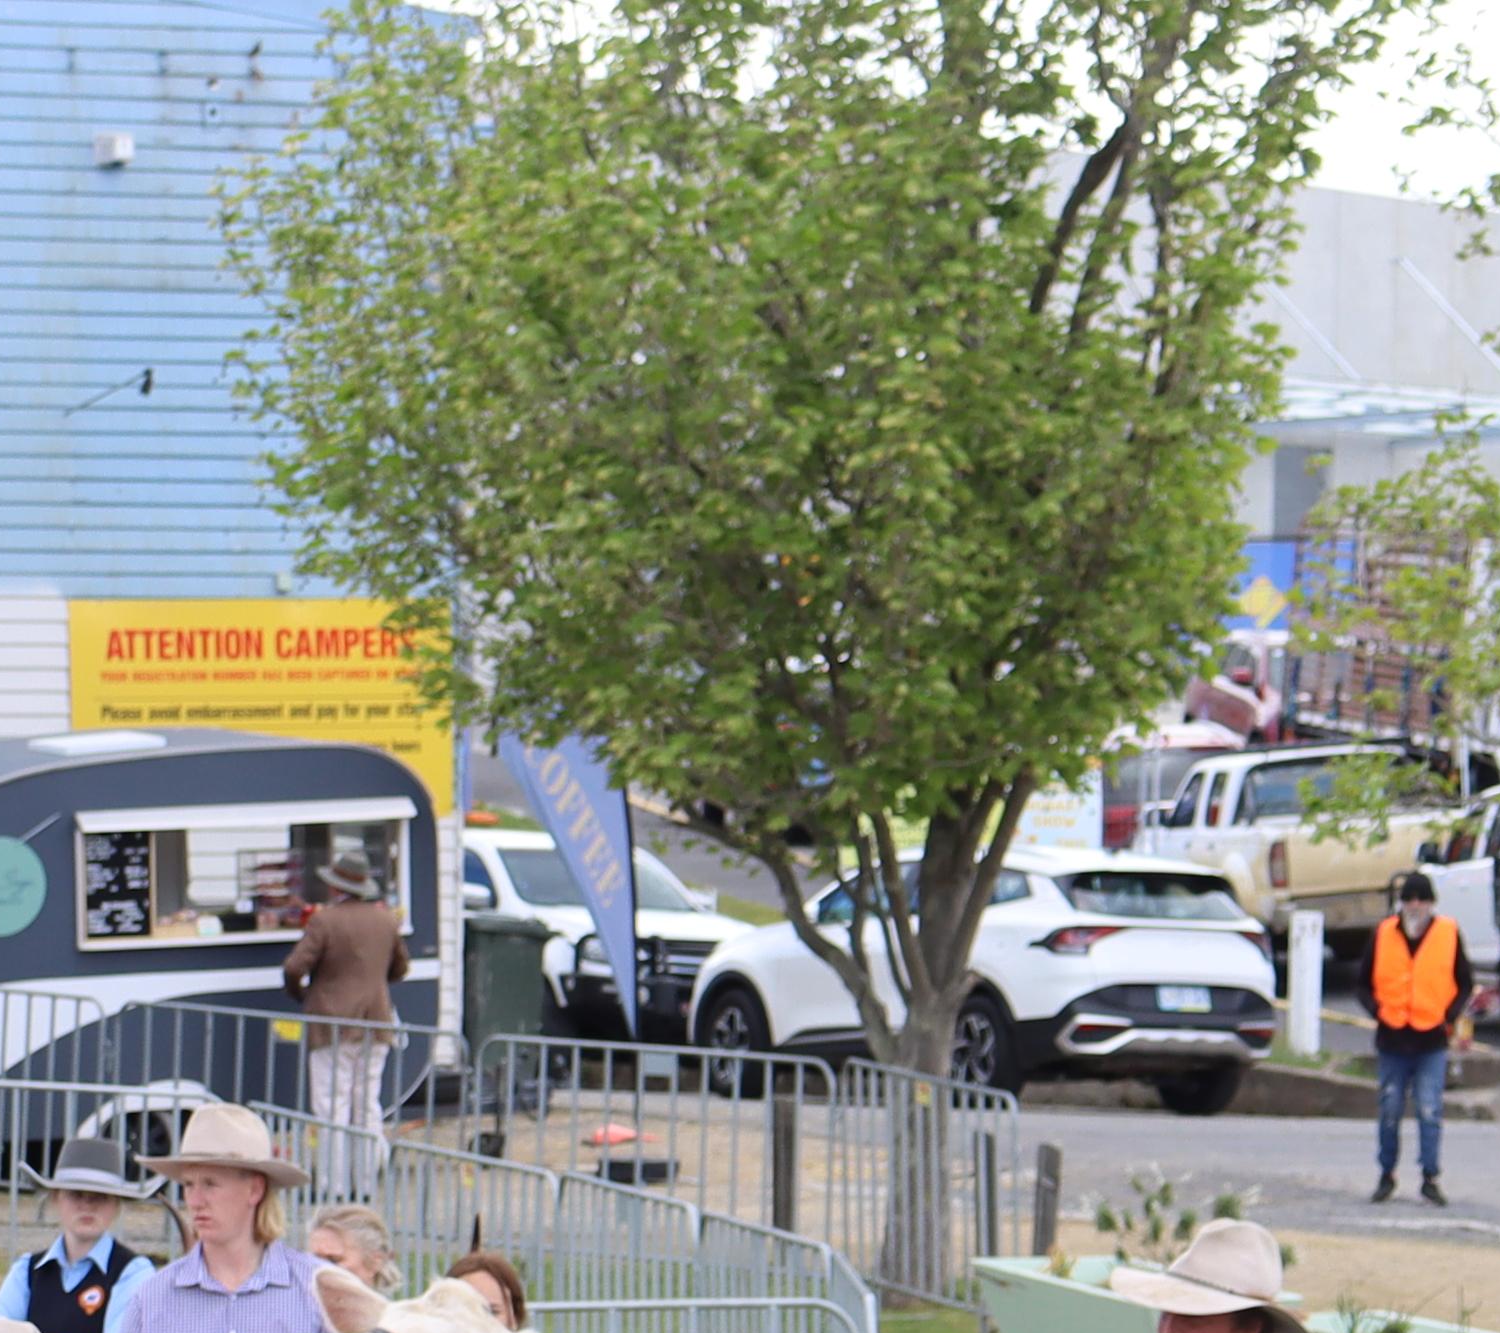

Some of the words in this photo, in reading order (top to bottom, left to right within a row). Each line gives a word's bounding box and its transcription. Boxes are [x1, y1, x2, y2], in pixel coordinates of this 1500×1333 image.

[106, 628, 264, 661] ATTENTION
[276, 628, 416, 660] CAMPERS
[101, 704, 142, 719] Please
[148, 705, 181, 719] avoid
[186, 704, 283, 719] embarrassment
[290, 704, 313, 718] and
[523, 732, 626, 908] COFFEE
